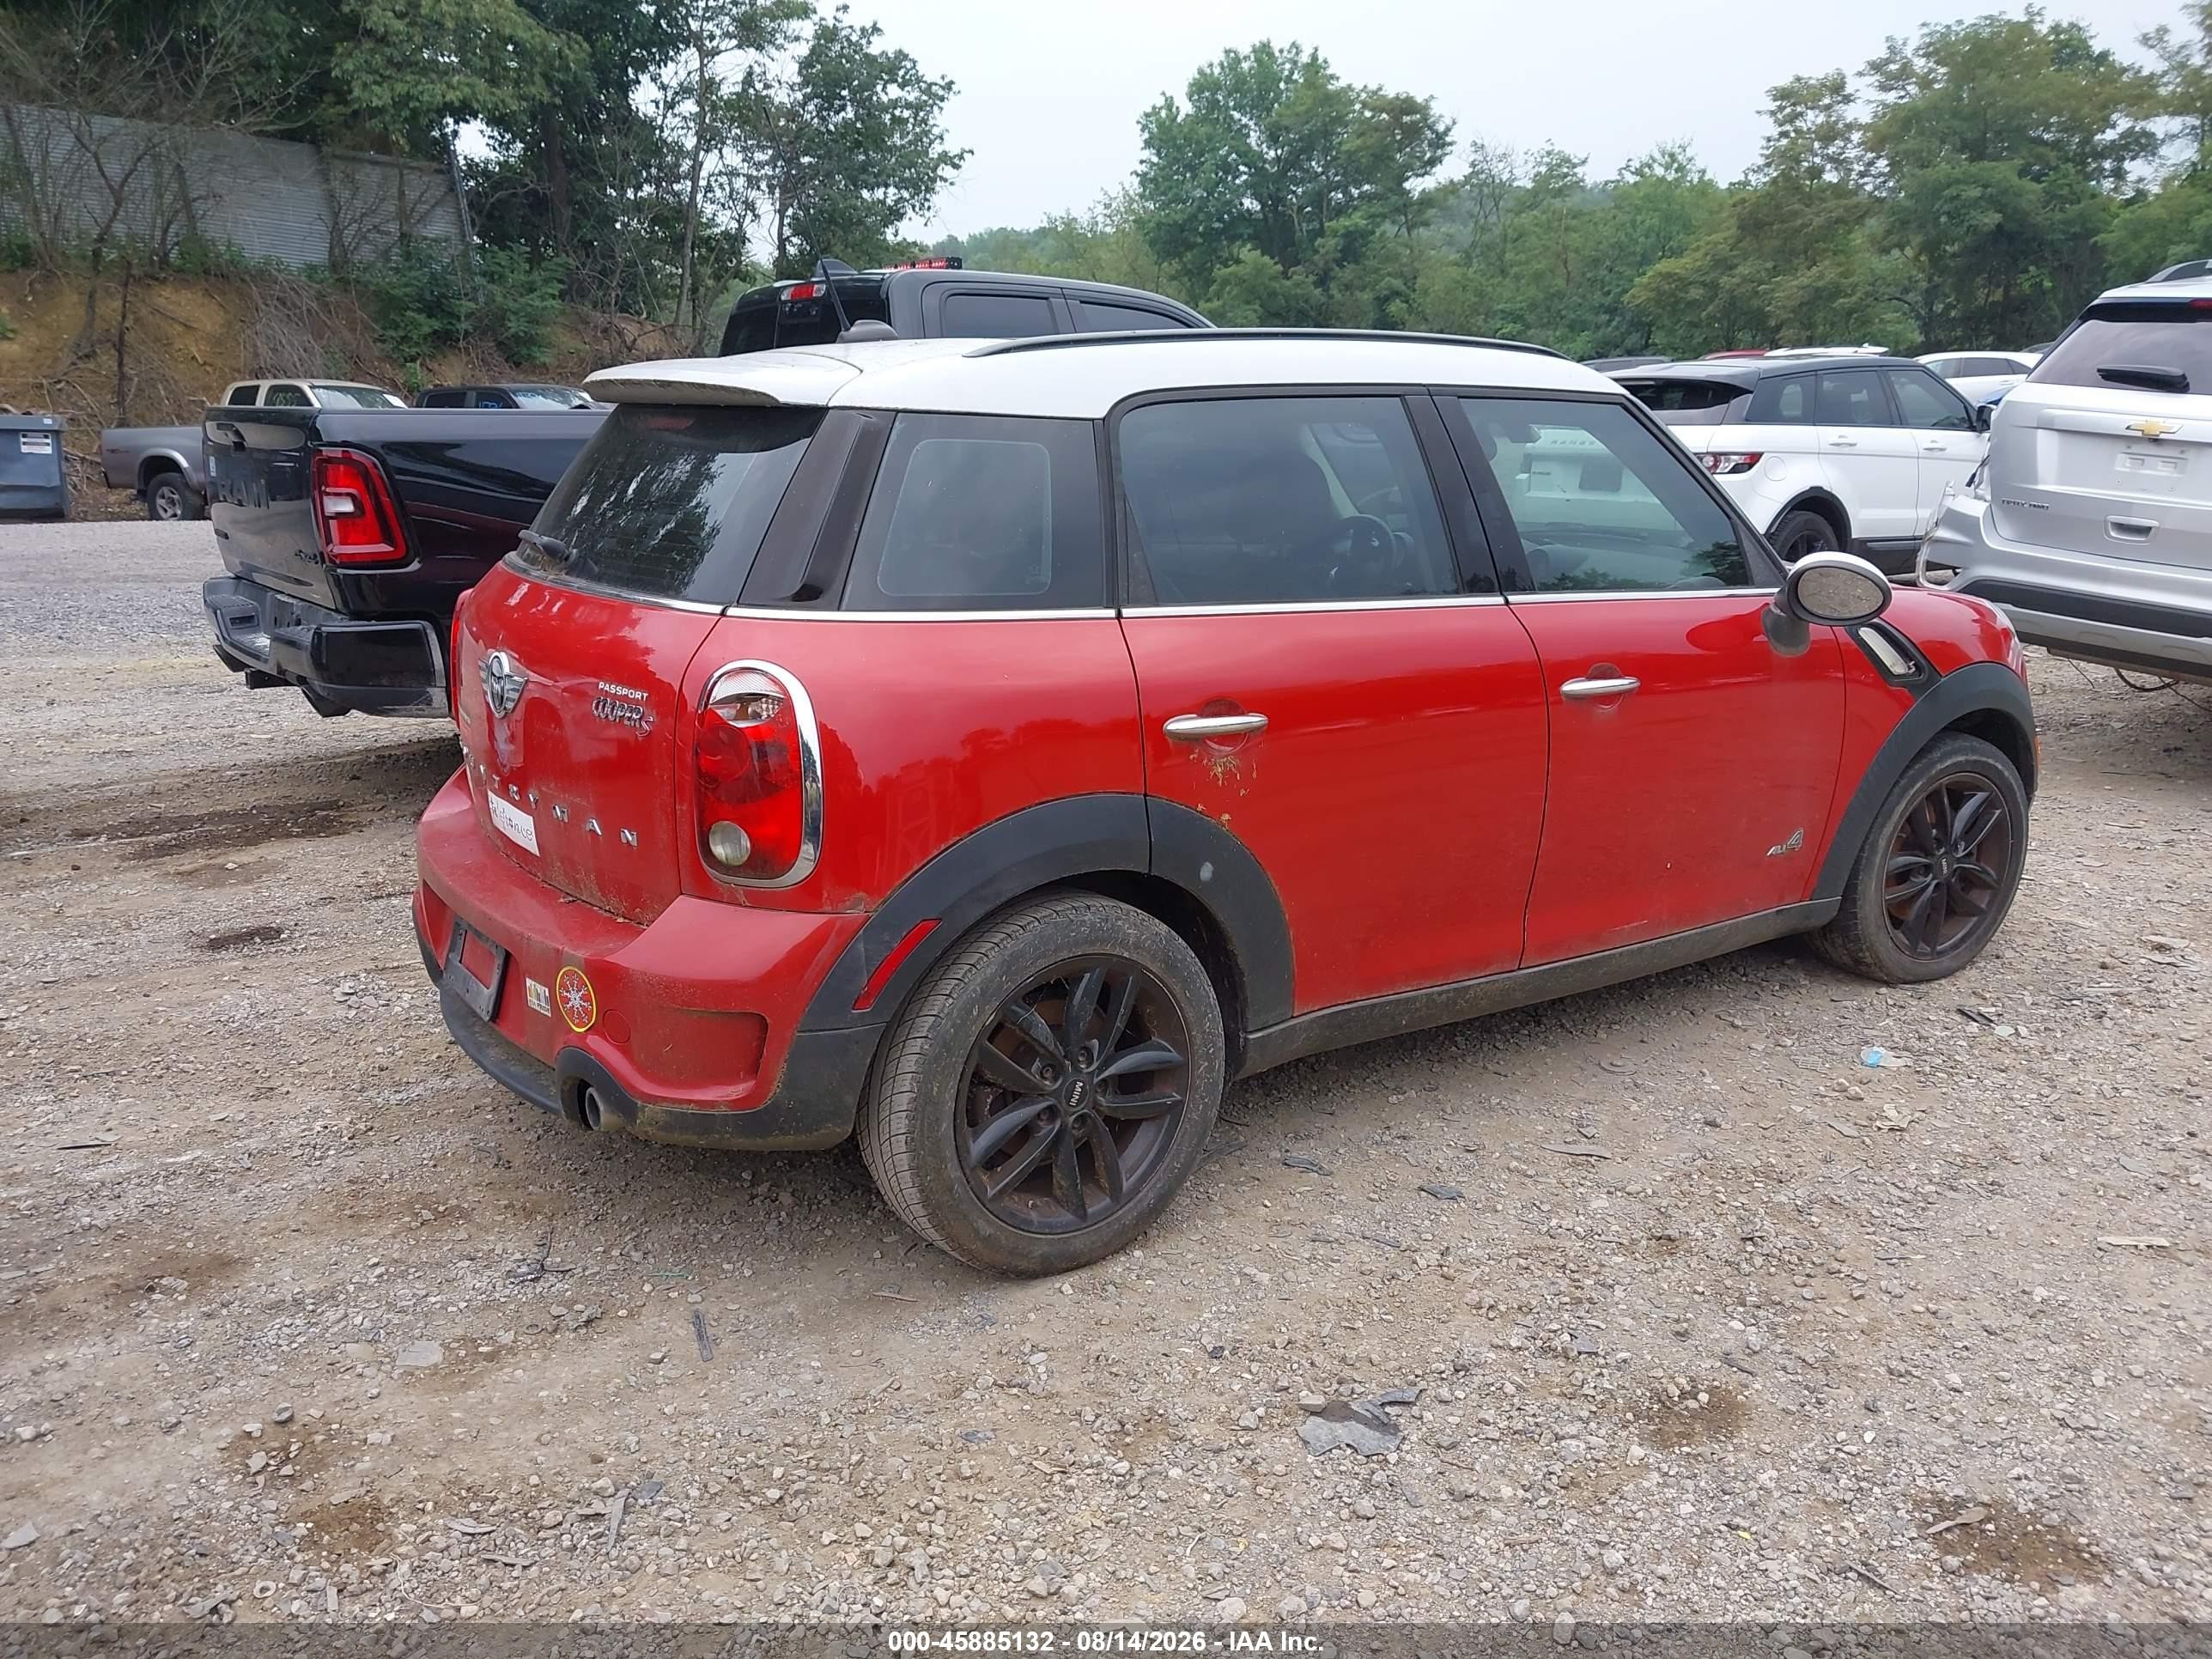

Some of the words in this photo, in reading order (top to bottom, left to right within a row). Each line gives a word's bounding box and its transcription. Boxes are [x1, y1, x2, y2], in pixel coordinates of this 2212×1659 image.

[218, 479, 270, 509] RAM
[599, 681, 648, 701] PASSPORT
[592, 696, 642, 727] COOPER
[635, 716, 653, 736] S
[1069, 1081, 1084, 1106] MINI
